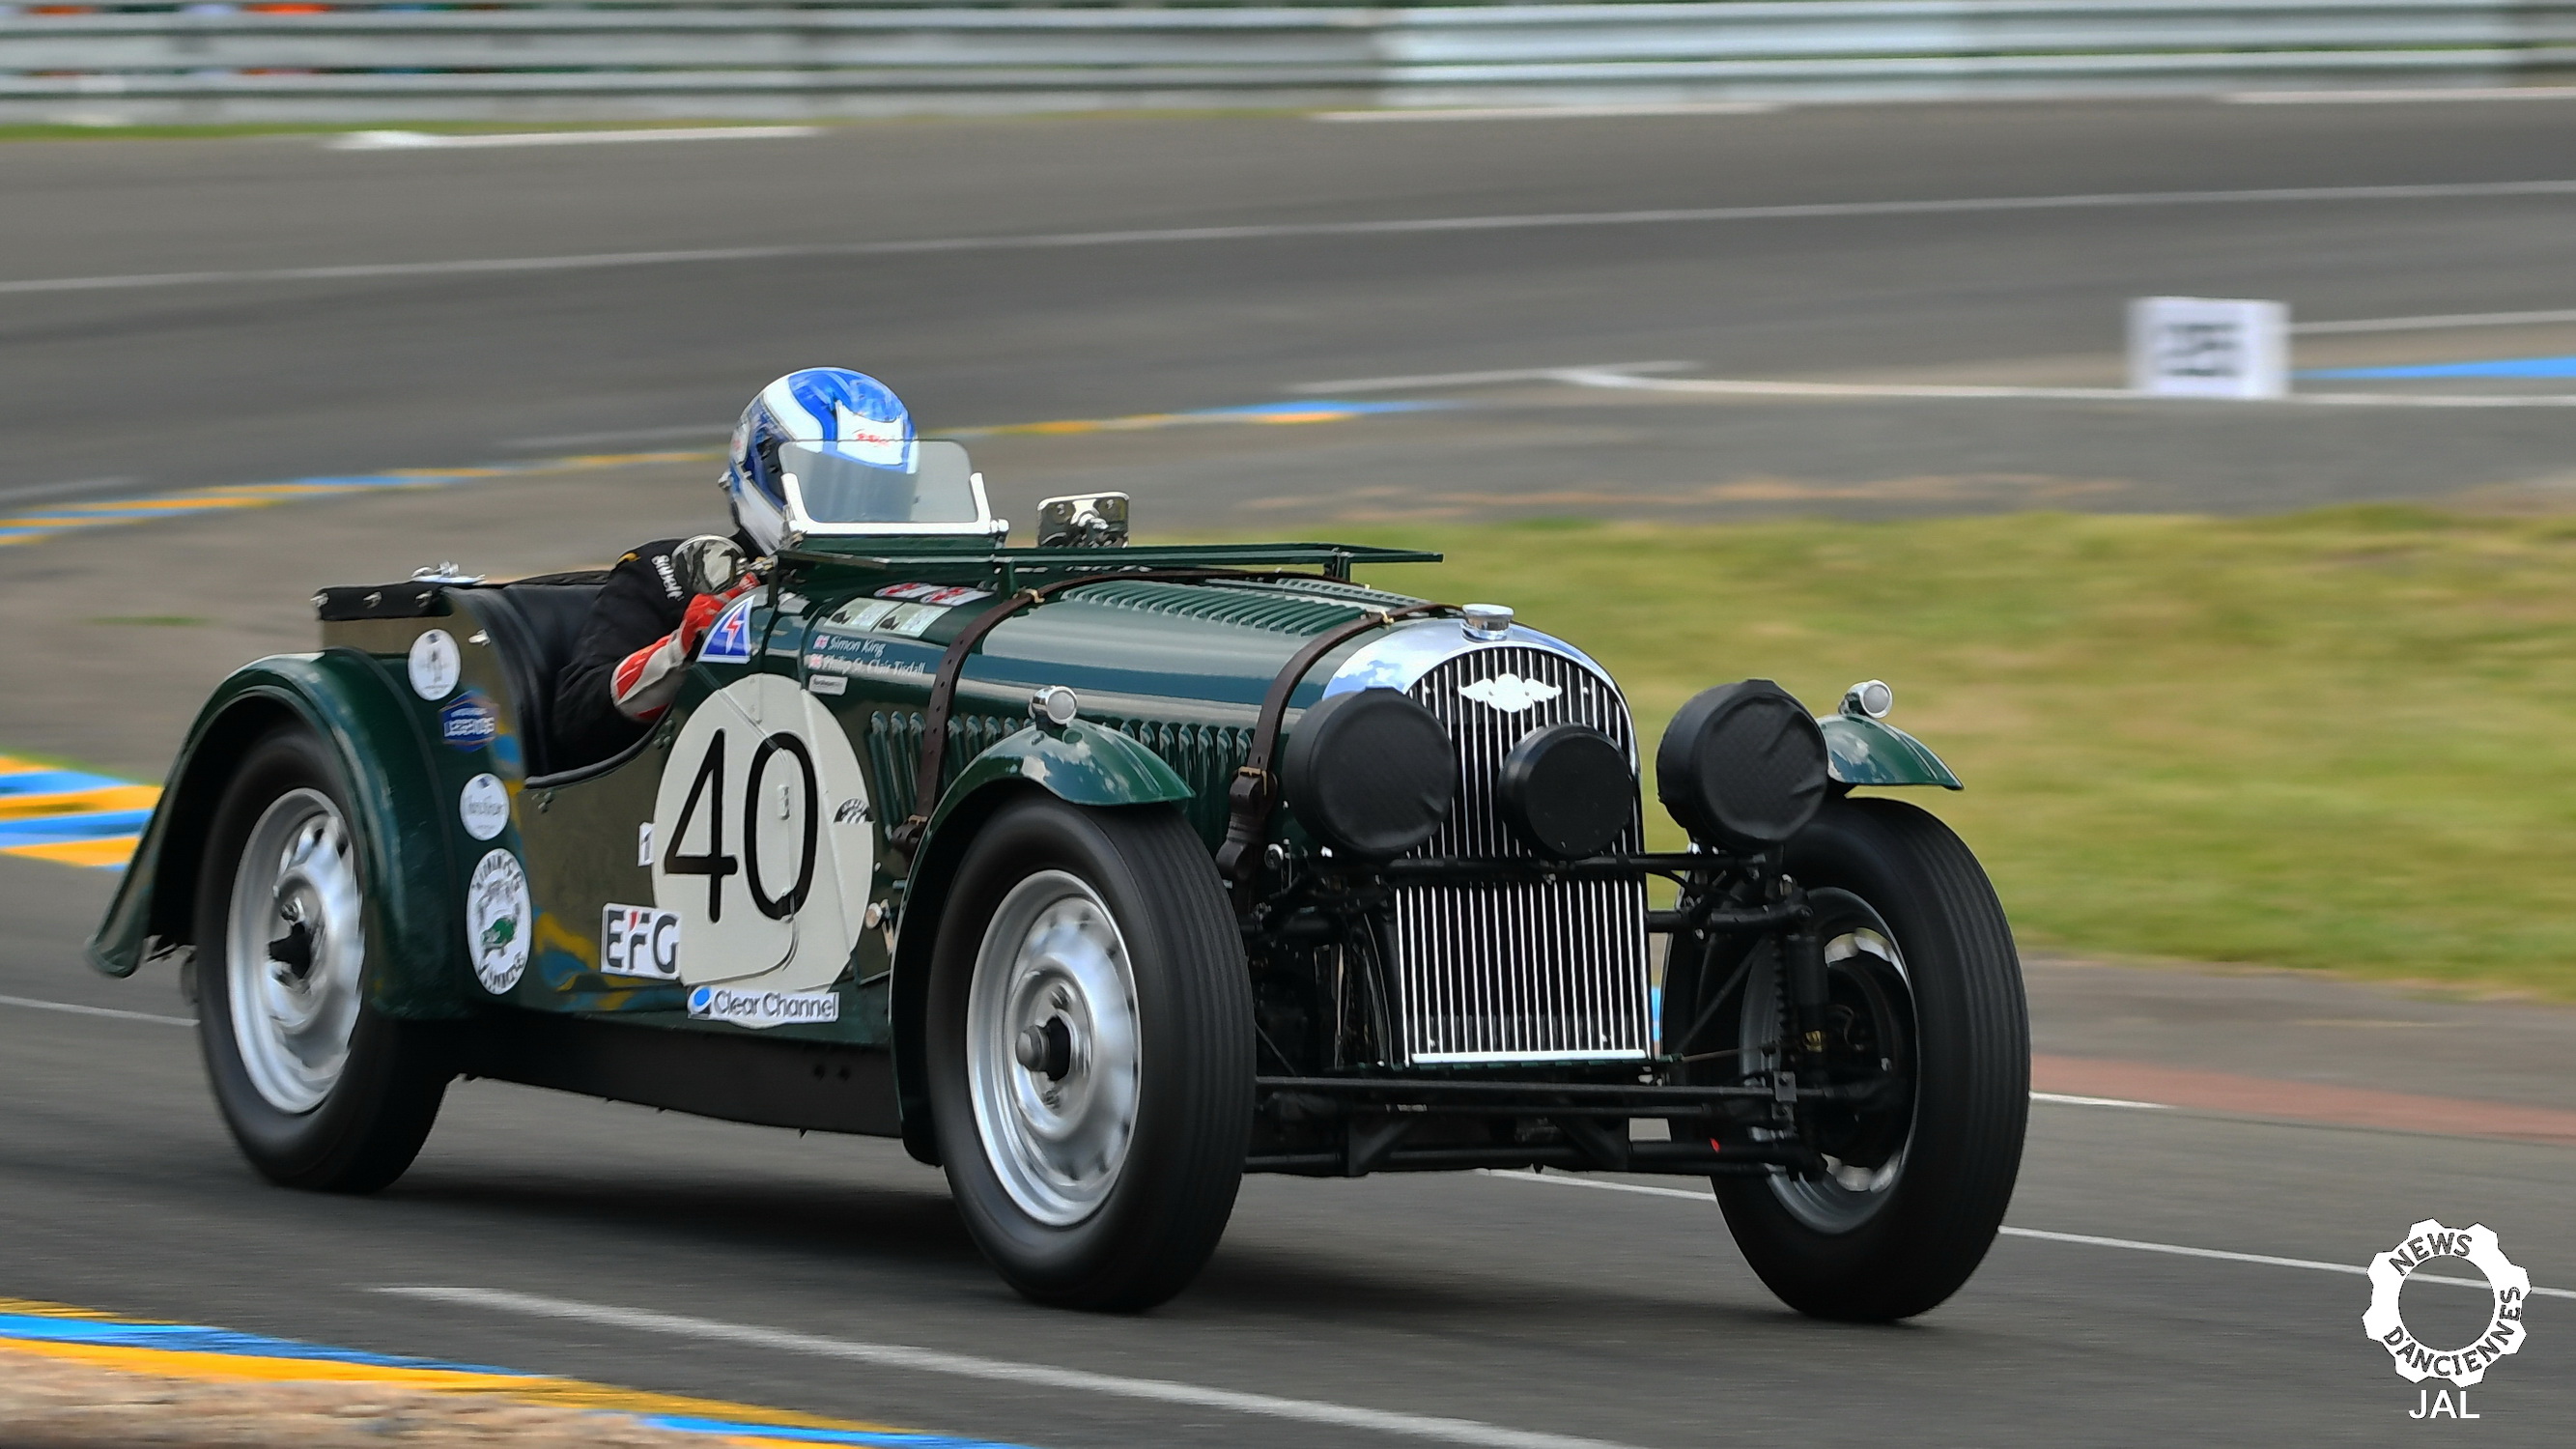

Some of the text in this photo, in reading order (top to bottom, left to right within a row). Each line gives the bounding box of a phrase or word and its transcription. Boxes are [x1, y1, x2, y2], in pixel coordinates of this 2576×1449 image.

[828, 635, 887, 659] Simon King
[664, 726, 819, 923] 40
[607, 910, 679, 974] EFG
[715, 989, 836, 1017] Clear Channel
